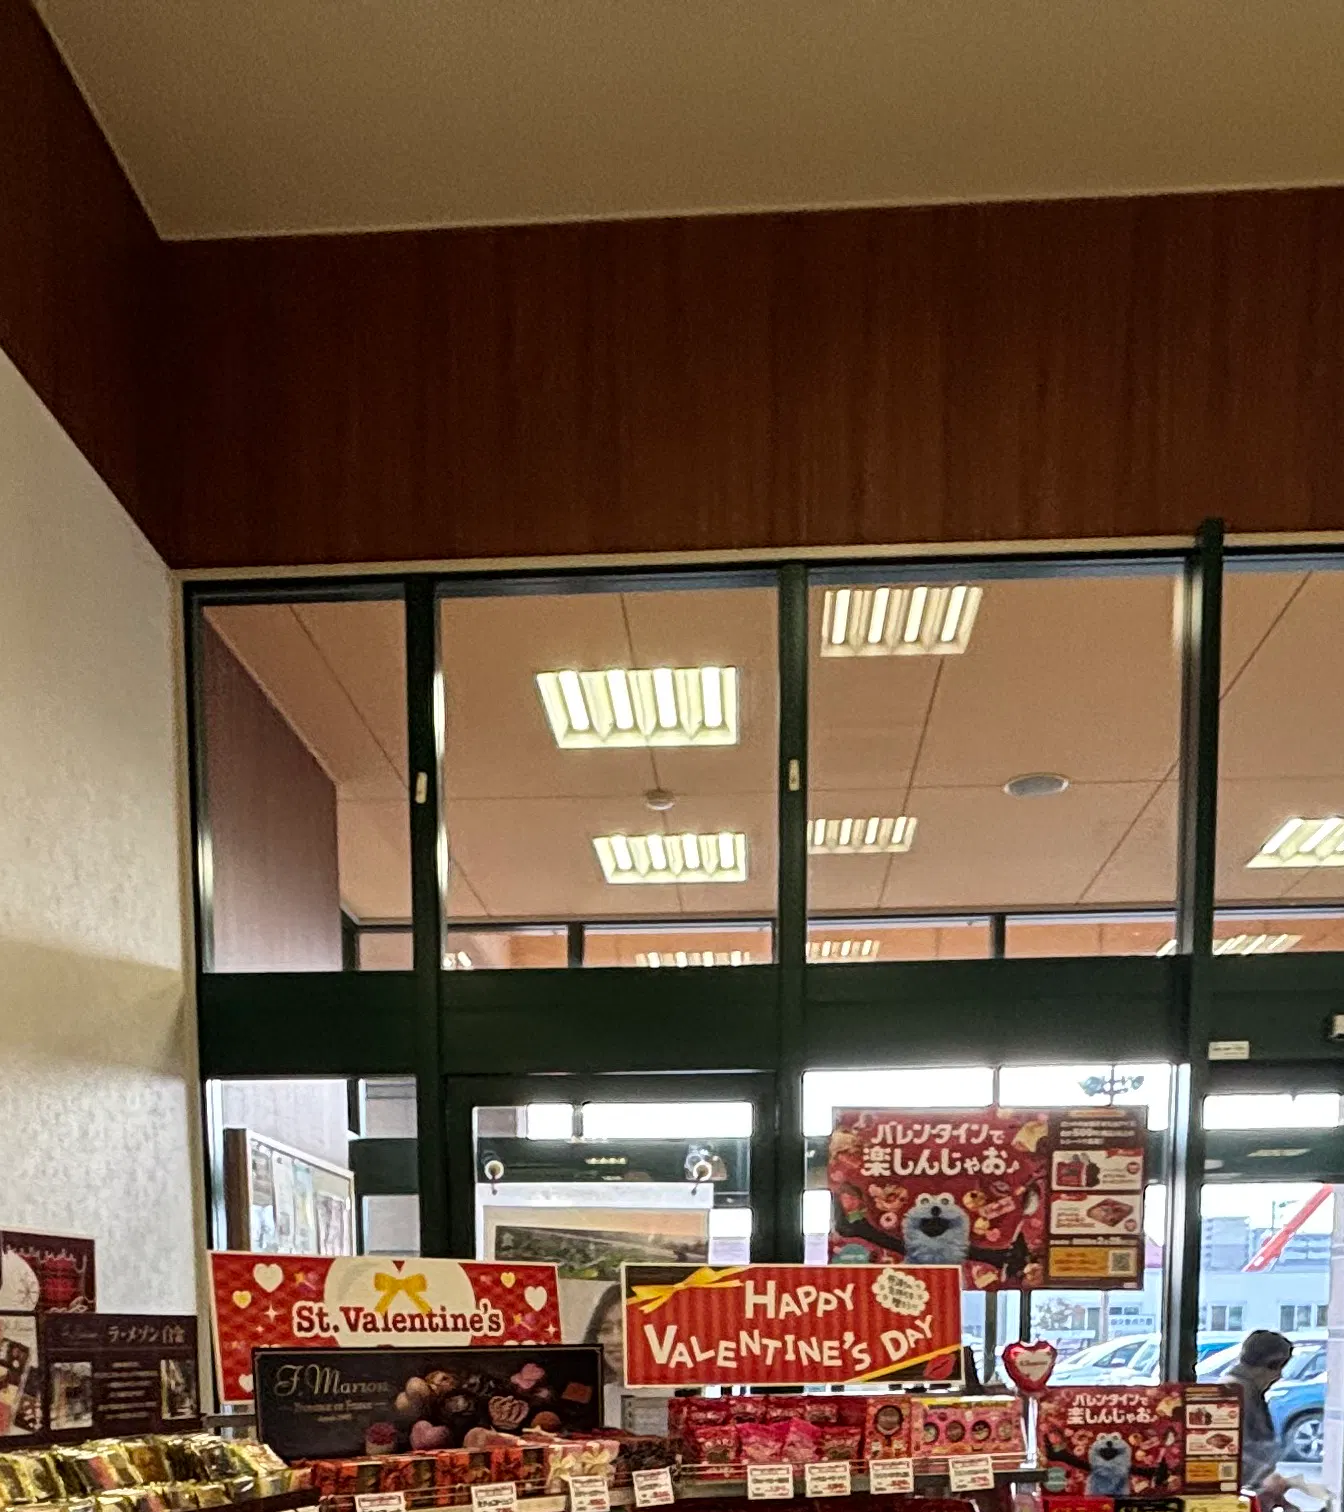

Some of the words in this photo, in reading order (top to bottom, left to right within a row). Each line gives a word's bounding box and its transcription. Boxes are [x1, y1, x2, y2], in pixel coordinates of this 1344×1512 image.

[871, 1121, 1006, 1145] バレンタインで
[745, 1279, 855, 1320] HAPPY
[644, 1323, 872, 1373] VALENTINE'S
[880, 1314, 934, 1362] DAY
